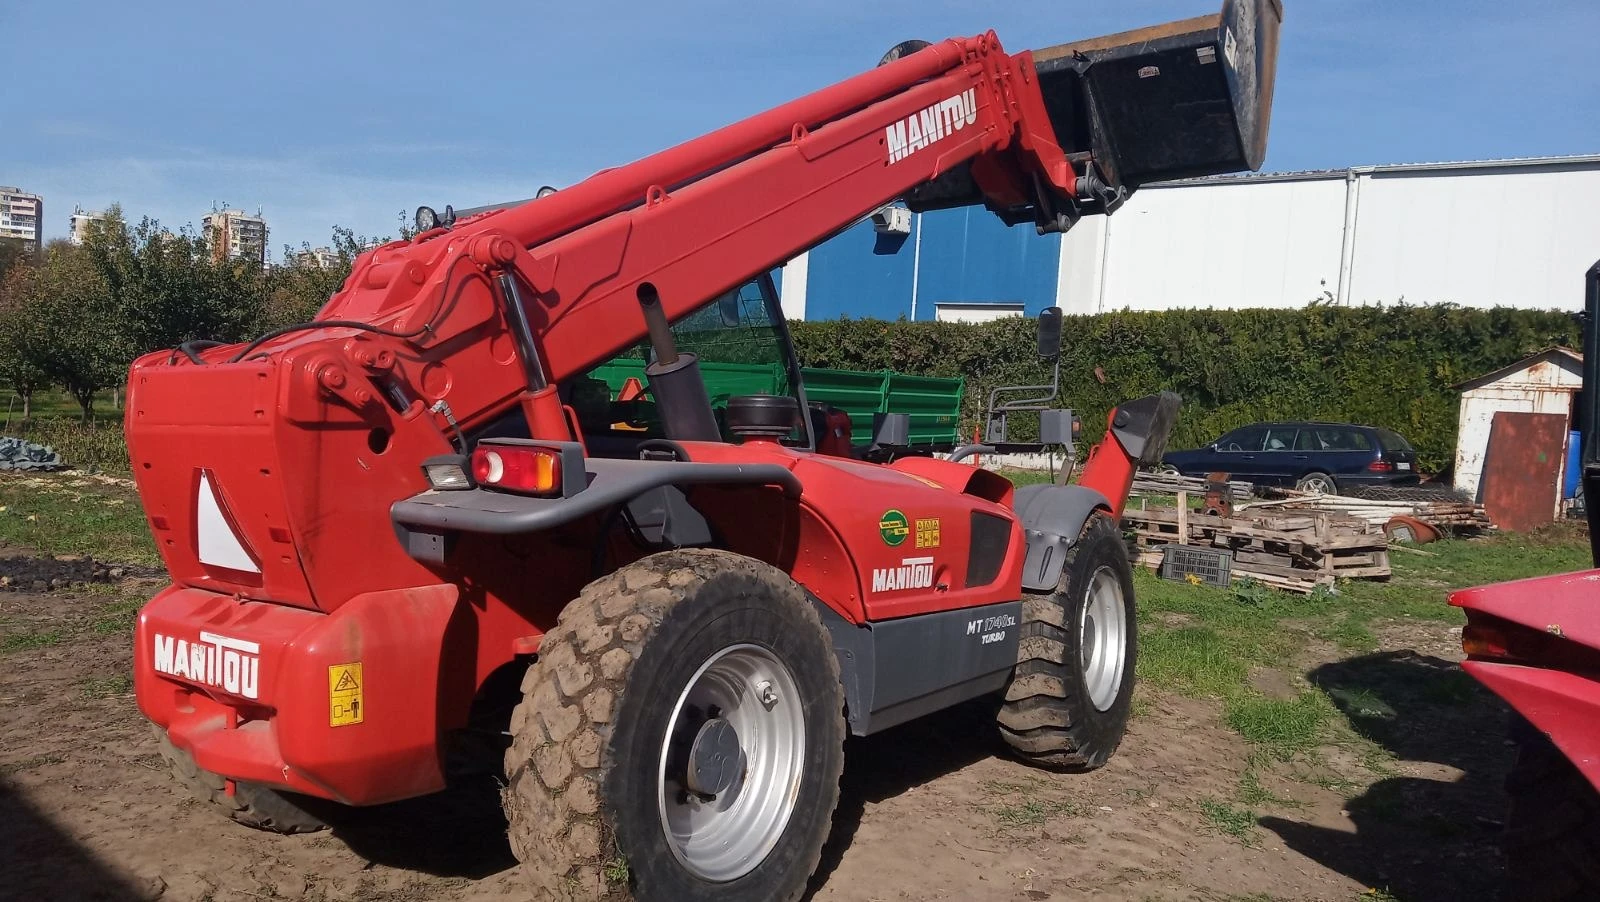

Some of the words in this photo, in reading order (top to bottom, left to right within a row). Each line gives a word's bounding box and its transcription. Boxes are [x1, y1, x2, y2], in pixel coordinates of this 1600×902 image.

[886, 87, 977, 165] MANITOU
[872, 556, 934, 593] MANITOU
[966, 619, 983, 635] MT
[981, 630, 1006, 645] TURBO
[154, 630, 259, 699] MANITOU
